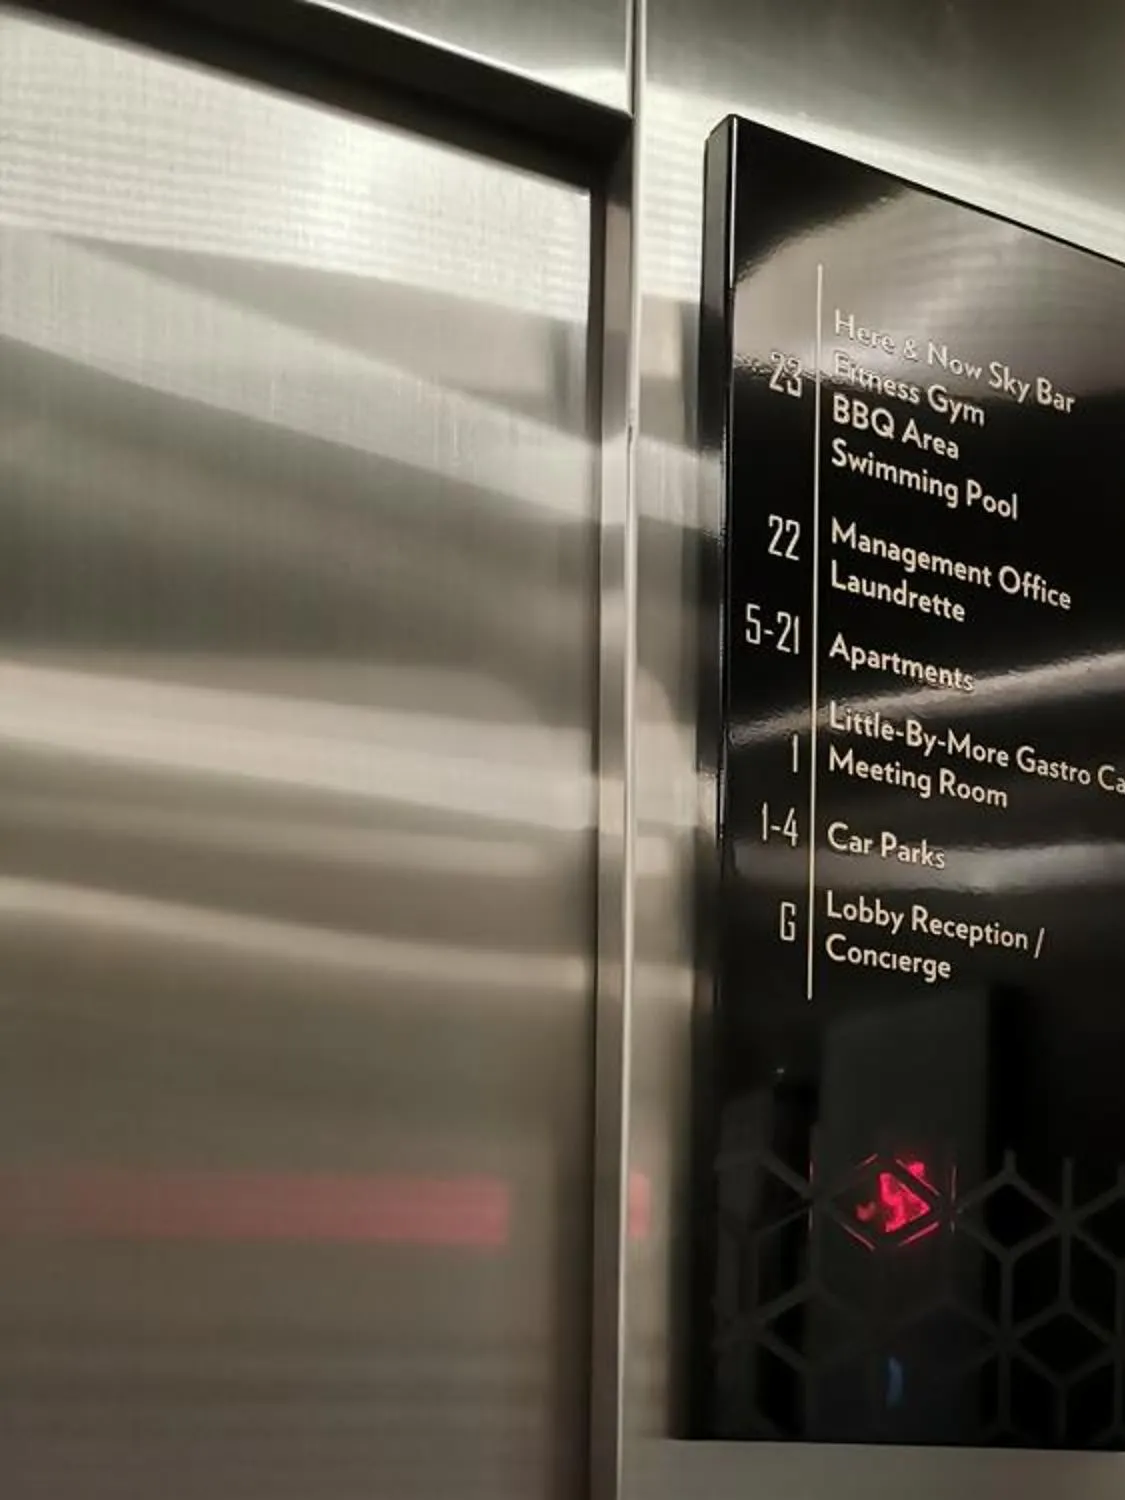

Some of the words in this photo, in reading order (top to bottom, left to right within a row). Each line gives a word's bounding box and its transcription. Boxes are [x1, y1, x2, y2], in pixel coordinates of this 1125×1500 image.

[769, 352, 802, 398] 23
[834, 309, 895, 354] Here
[904, 336, 918, 361] &
[928, 344, 982, 381] Now
[989, 361, 1031, 404] Sky
[1036, 376, 1075, 414] Bar
[834, 352, 920, 405] Fitness
[927, 383, 985, 426] Gym
[832, 393, 894, 439] BBQ
[902, 423, 960, 460] Area
[832, 438, 959, 509] Swimming
[966, 480, 1018, 521] Pool
[768, 514, 800, 561] 22
[832, 516, 992, 588] Management
[999, 565, 1071, 611] Office
[831, 560, 966, 622] Laundrette
[745, 603, 799, 655] 5-21
[829, 633, 975, 693] Apartments
[829, 700, 1009, 768] Little-By-More
[1017, 746, 1091, 787] Gastro
[829, 746, 931, 798] Meeting
[940, 770, 1008, 808] Room
[762, 802, 798, 847] 1-4
[828, 821, 873, 855] Car
[881, 832, 946, 870] Parks
[779, 902, 796, 941] G
[826, 890, 904, 934] Lobby
[912, 906, 1028, 951] Reception
[825, 934, 951, 983] Concierge
